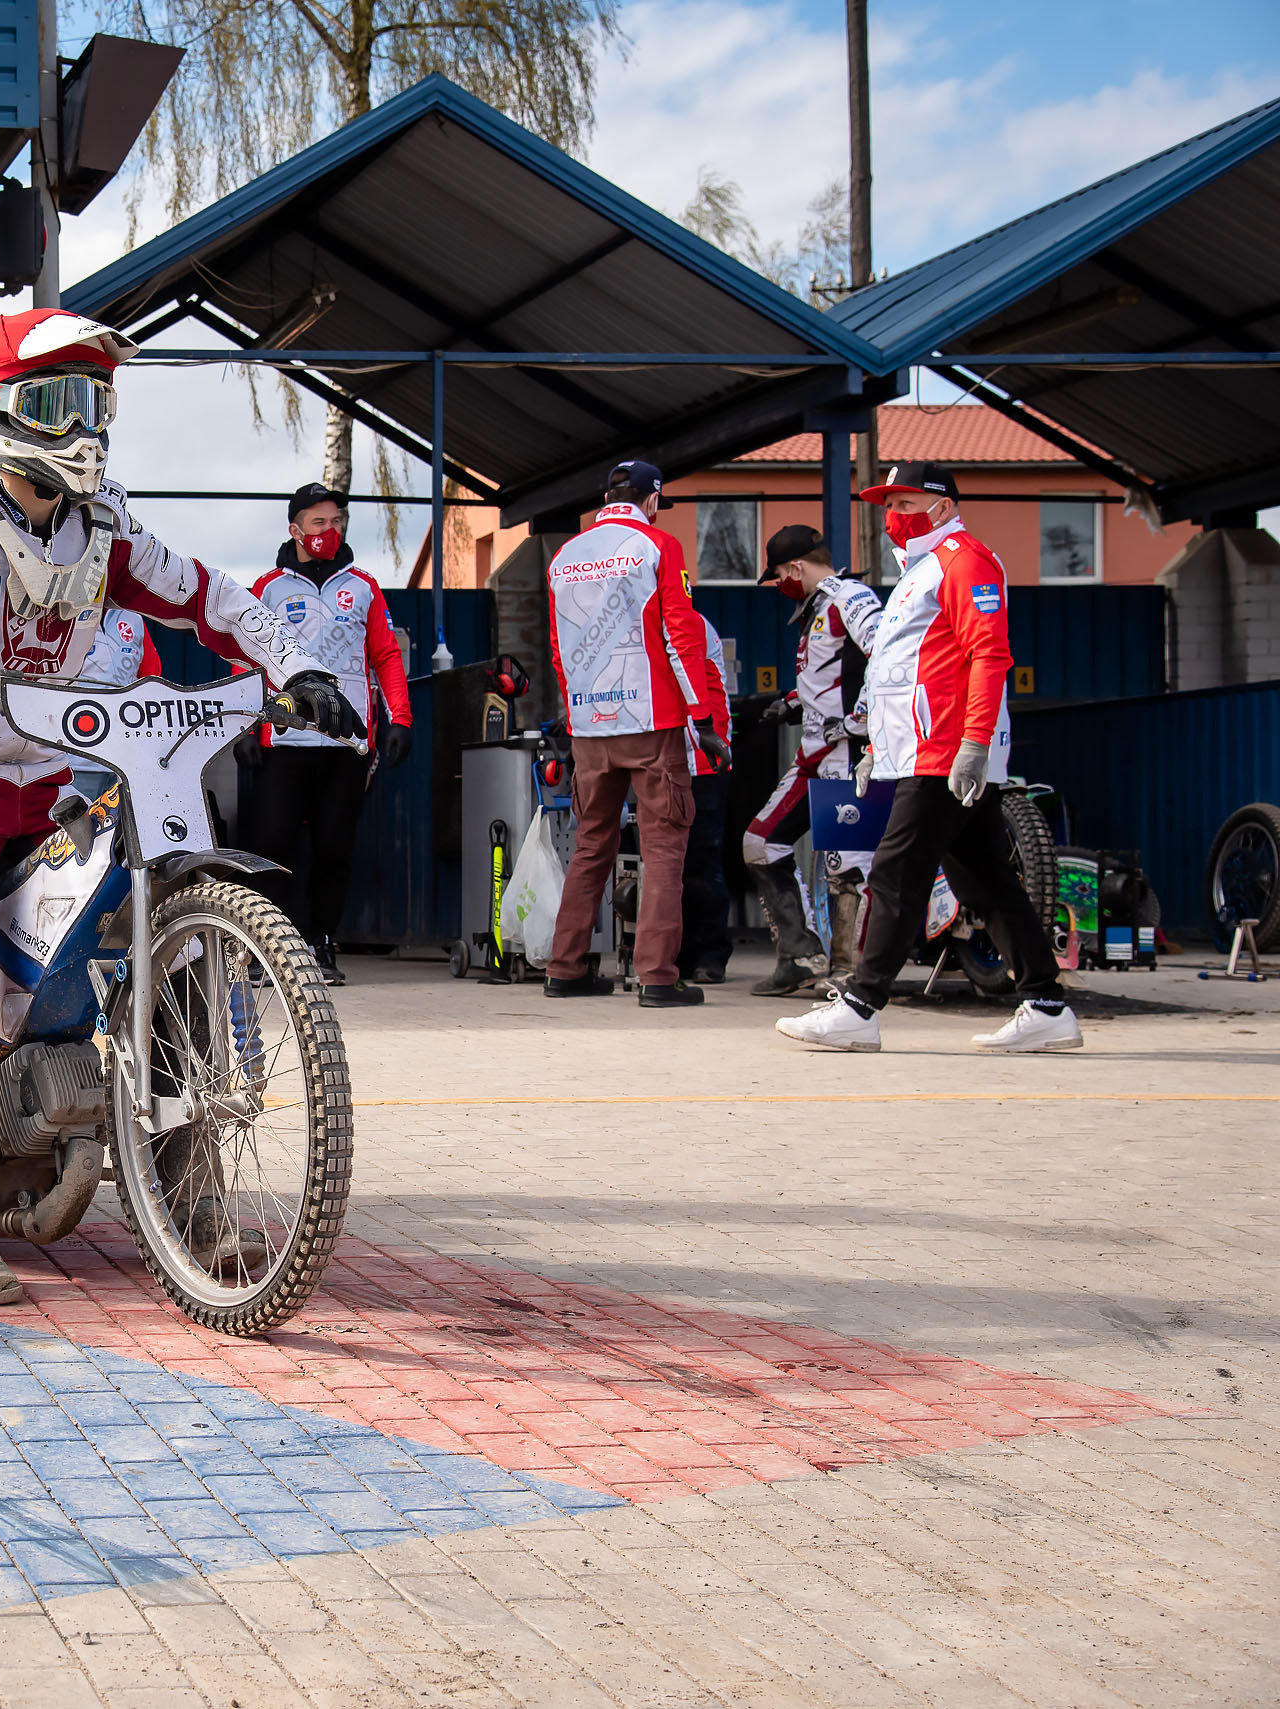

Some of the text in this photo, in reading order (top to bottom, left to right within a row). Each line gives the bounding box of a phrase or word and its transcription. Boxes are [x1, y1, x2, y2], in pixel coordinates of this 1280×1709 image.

[82, 530, 112, 604] ATLAS
[554, 556, 644, 577] LOKOMOTIV
[564, 569, 628, 583] DAUGAVPILS
[762, 671, 773, 688] 3
[1020, 672, 1029, 687] 4
[584, 689, 638, 704] LOKOMOTIVE.LV
[119, 699, 224, 729] OPTIBET
[125, 727, 226, 739] SPORTA BĀRS
